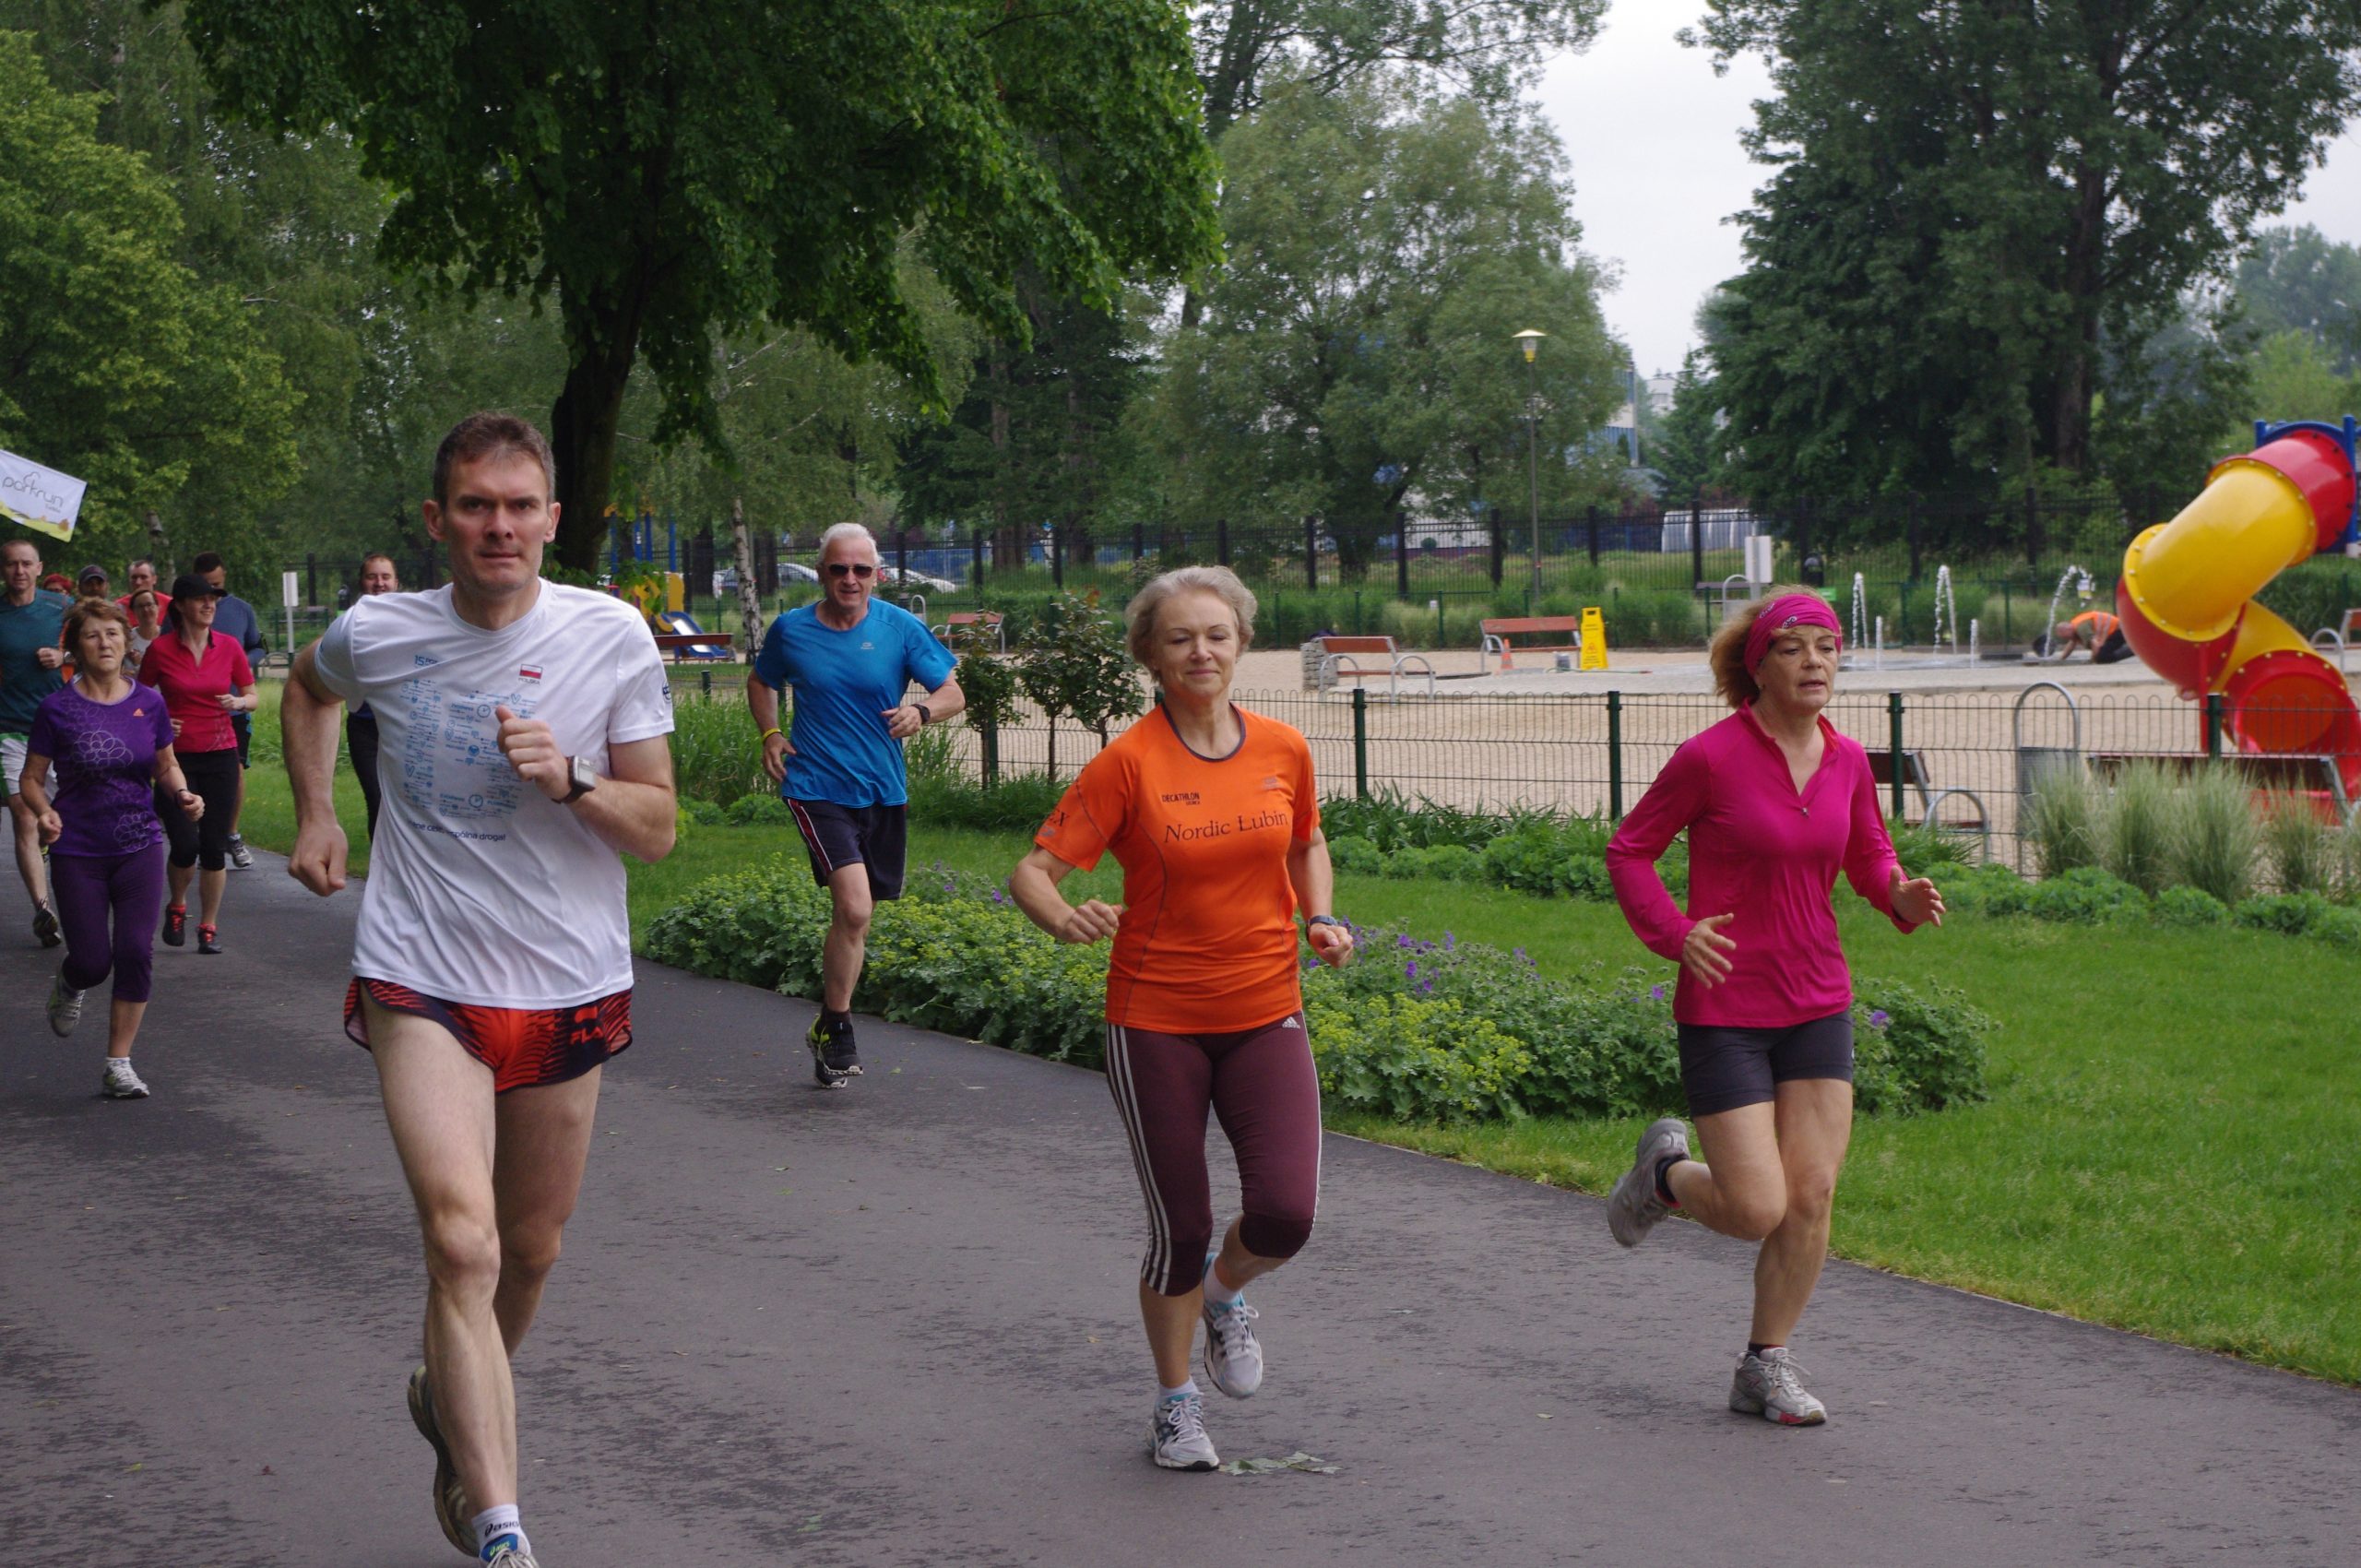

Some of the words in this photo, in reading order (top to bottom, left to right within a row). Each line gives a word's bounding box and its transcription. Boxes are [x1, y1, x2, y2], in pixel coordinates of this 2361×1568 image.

[2, 475, 65, 507] parkrun
[1161, 792, 1200, 802] DECATHLON
[1163, 820, 1231, 843] Nordic
[1238, 811, 1288, 832] Lubin
